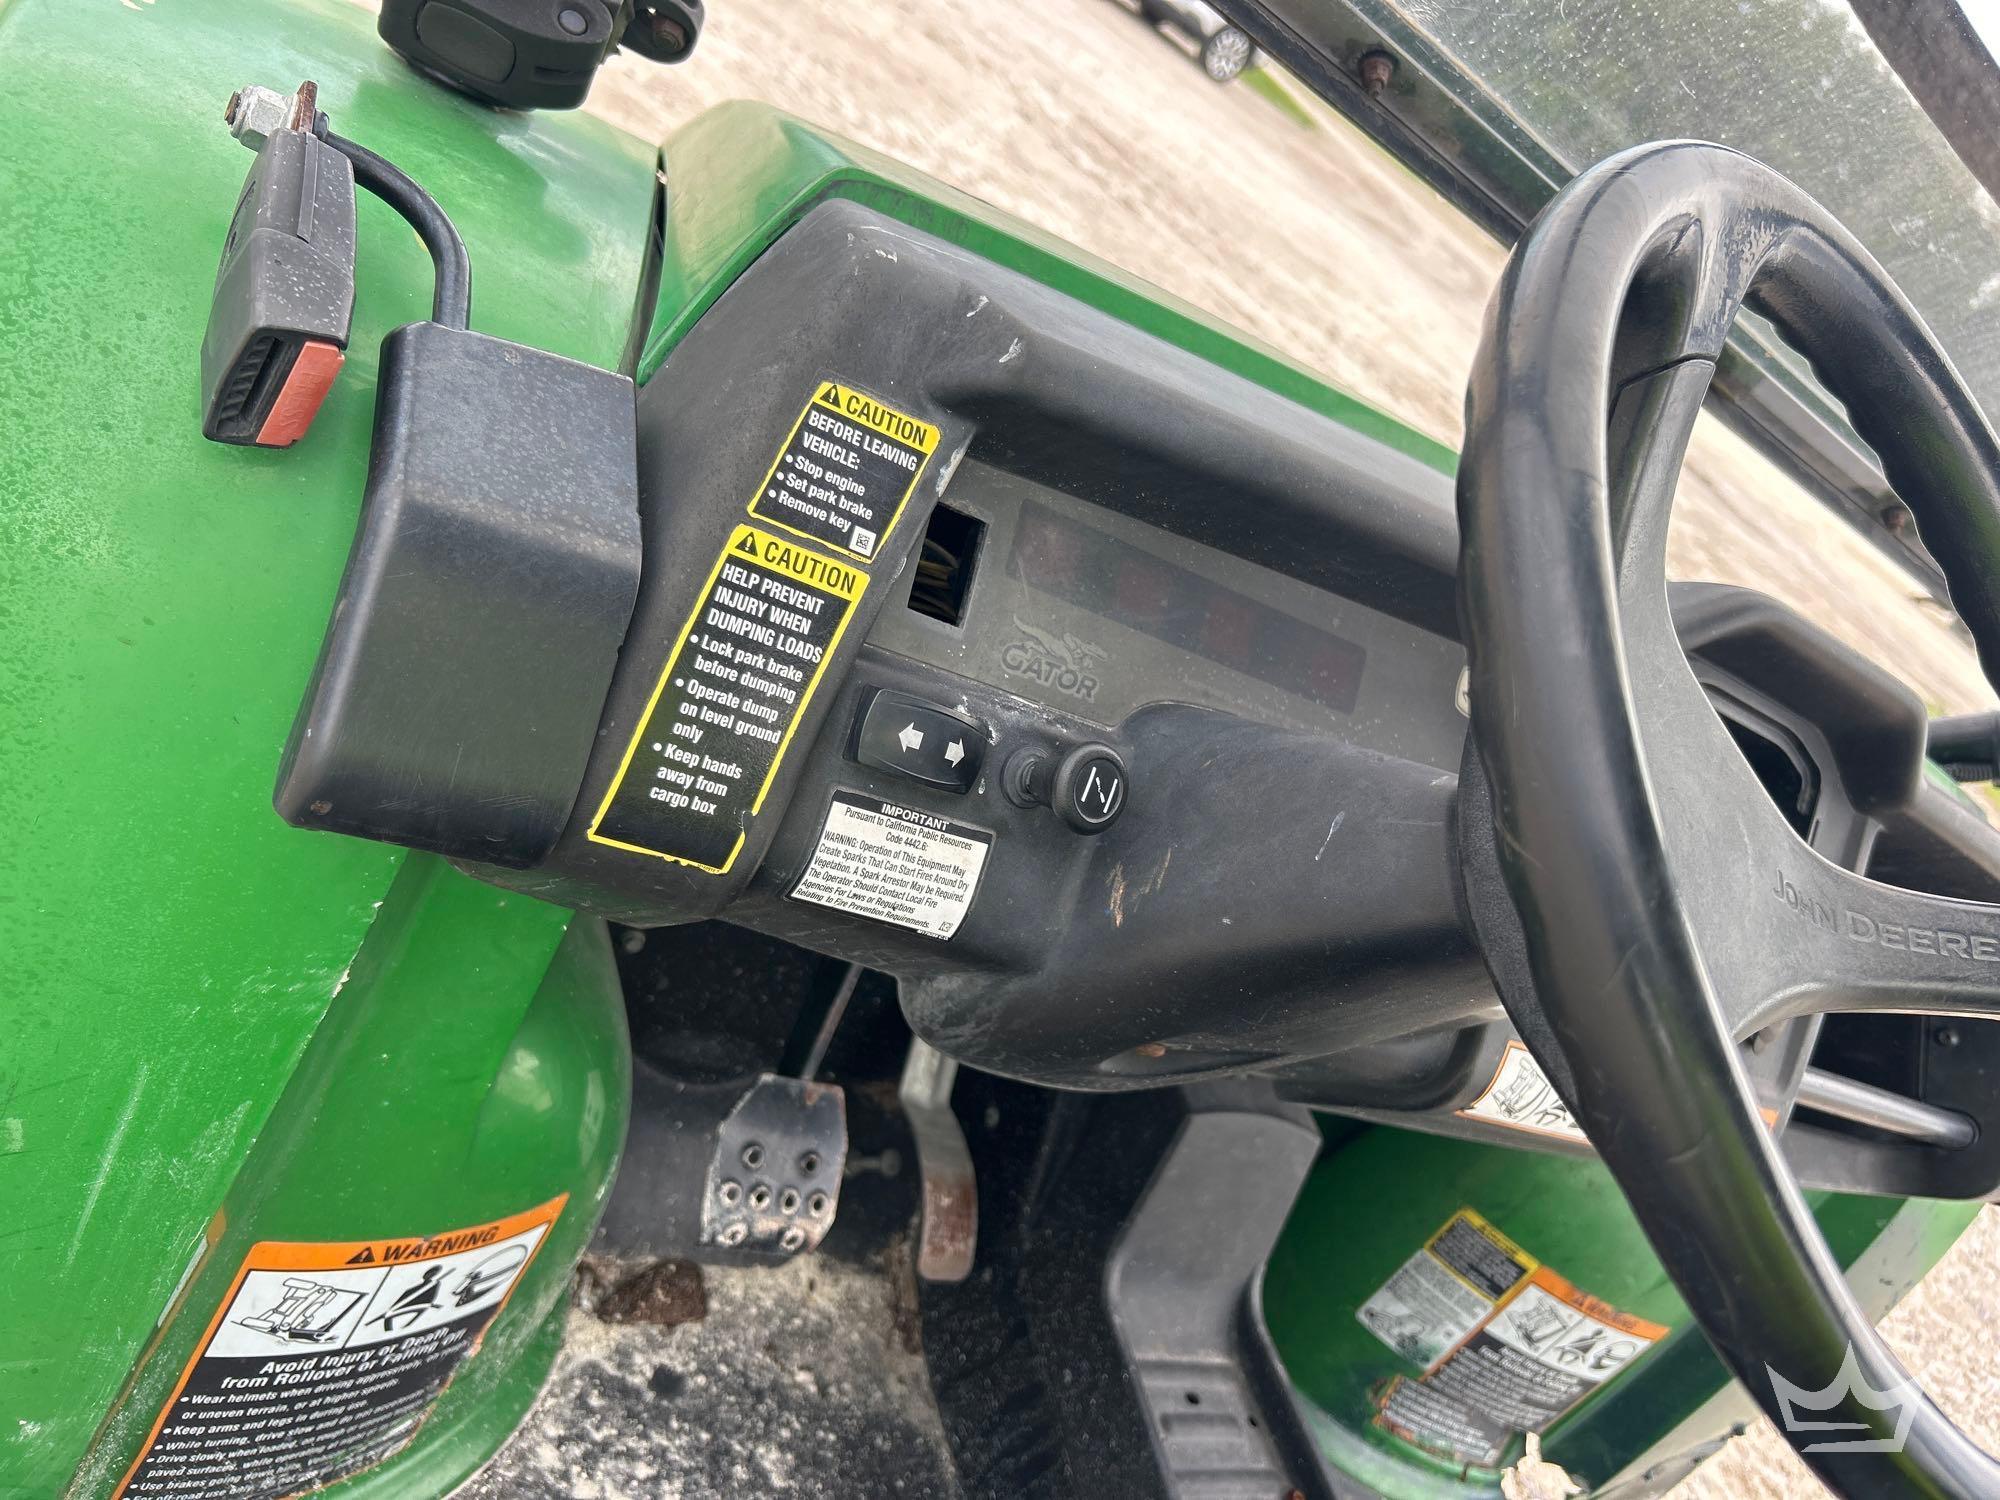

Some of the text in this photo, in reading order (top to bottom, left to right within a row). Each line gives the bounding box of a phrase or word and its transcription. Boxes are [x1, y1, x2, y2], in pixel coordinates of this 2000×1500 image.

[808, 410, 917, 471] BEFORE LEAVING
[846, 395, 927, 447] CAUTION
[803, 432, 860, 470] VEHICLE:
[786, 473, 873, 520] Set park brake
[795, 455, 865, 497] Stop engine
[778, 490, 852, 533] Remove key
[764, 541, 857, 594] CAUTION
[721, 563, 824, 615] HELP PREVENT
[714, 586, 812, 635] INJURY WHEN
[707, 608, 824, 664] DUMPING LOADS
[694, 654, 797, 704] before dumping
[701, 635, 803, 683] Lock park brake
[1001, 643, 1098, 700] GATOR
[687, 679, 779, 723] Operate dump
[672, 722, 704, 743] only
[679, 702, 782, 744] on level ground
[657, 766, 728, 797] away from
[664, 743, 743, 780] Keep hands
[650, 787, 718, 816] cargo box
[881, 803, 950, 832] IMPORTANT
[845, 807, 973, 851] Pursuant to California Public Resources
[886, 832, 903, 844] Code
[819, 843, 970, 892] Create Sparks That Can Start Fires Around Dry
[824, 830, 966, 878] WARNING: Operation of This Equipment May
[801, 879, 835, 893] Agencies
[834, 887, 847, 897] For
[847, 890, 867, 902] Laws
[875, 896, 916, 914] Regulations
[808, 867, 939, 908] The Operator Should Contact Local Fire
[814, 855, 965, 903] Vegetation. A Spark Arrestor May be Required.
[795, 888, 824, 901] Relating
[833, 897, 848, 907] Fire
[848, 901, 884, 917] Prevention
[885, 910, 930, 928] Requirements.
[1773, 868, 2000, 962] JOHN DEERE
[383, 1226, 499, 1262] WARNING
[221, 1377, 269, 1389] from
[273, 1365, 355, 1386] Rollover
[358, 1359, 378, 1372] or
[381, 1341, 440, 1367] Falling
[259, 1357, 318, 1374] Avoid
[320, 1349, 376, 1368] Injury
[378, 1343, 399, 1356] or
[401, 1327, 450, 1351] Death
[182, 1411, 197, 1420] or
[198, 1408, 244, 1420] uneven
[294, 1401, 308, 1411] or
[308, 1398, 322, 1408] at
[192, 1395, 225, 1404] Wear
[227, 1391, 278, 1403] helmets
[280, 1387, 312, 1399] when
[166, 1441, 202, 1451] While
[254, 1431, 285, 1442] drive
[287, 1425, 315, 1437] slow
[173, 1425, 205, 1436] Keep
[208, 1422, 240, 1434] arms
[242, 1420, 266, 1431] and
[268, 1417, 294, 1429] legs
[295, 1414, 308, 1423] in
[147, 1466, 186, 1478] paved
[242, 1457, 274, 1469] while
[156, 1454, 187, 1464] Drive
[189, 1450, 228, 1462] slowly
[228, 1447, 258, 1459] when
[140, 1481, 164, 1491] Use
[167, 1479, 206, 1490] brakes
[208, 1475, 241, 1488] going
[205, 1489, 227, 1499] use
